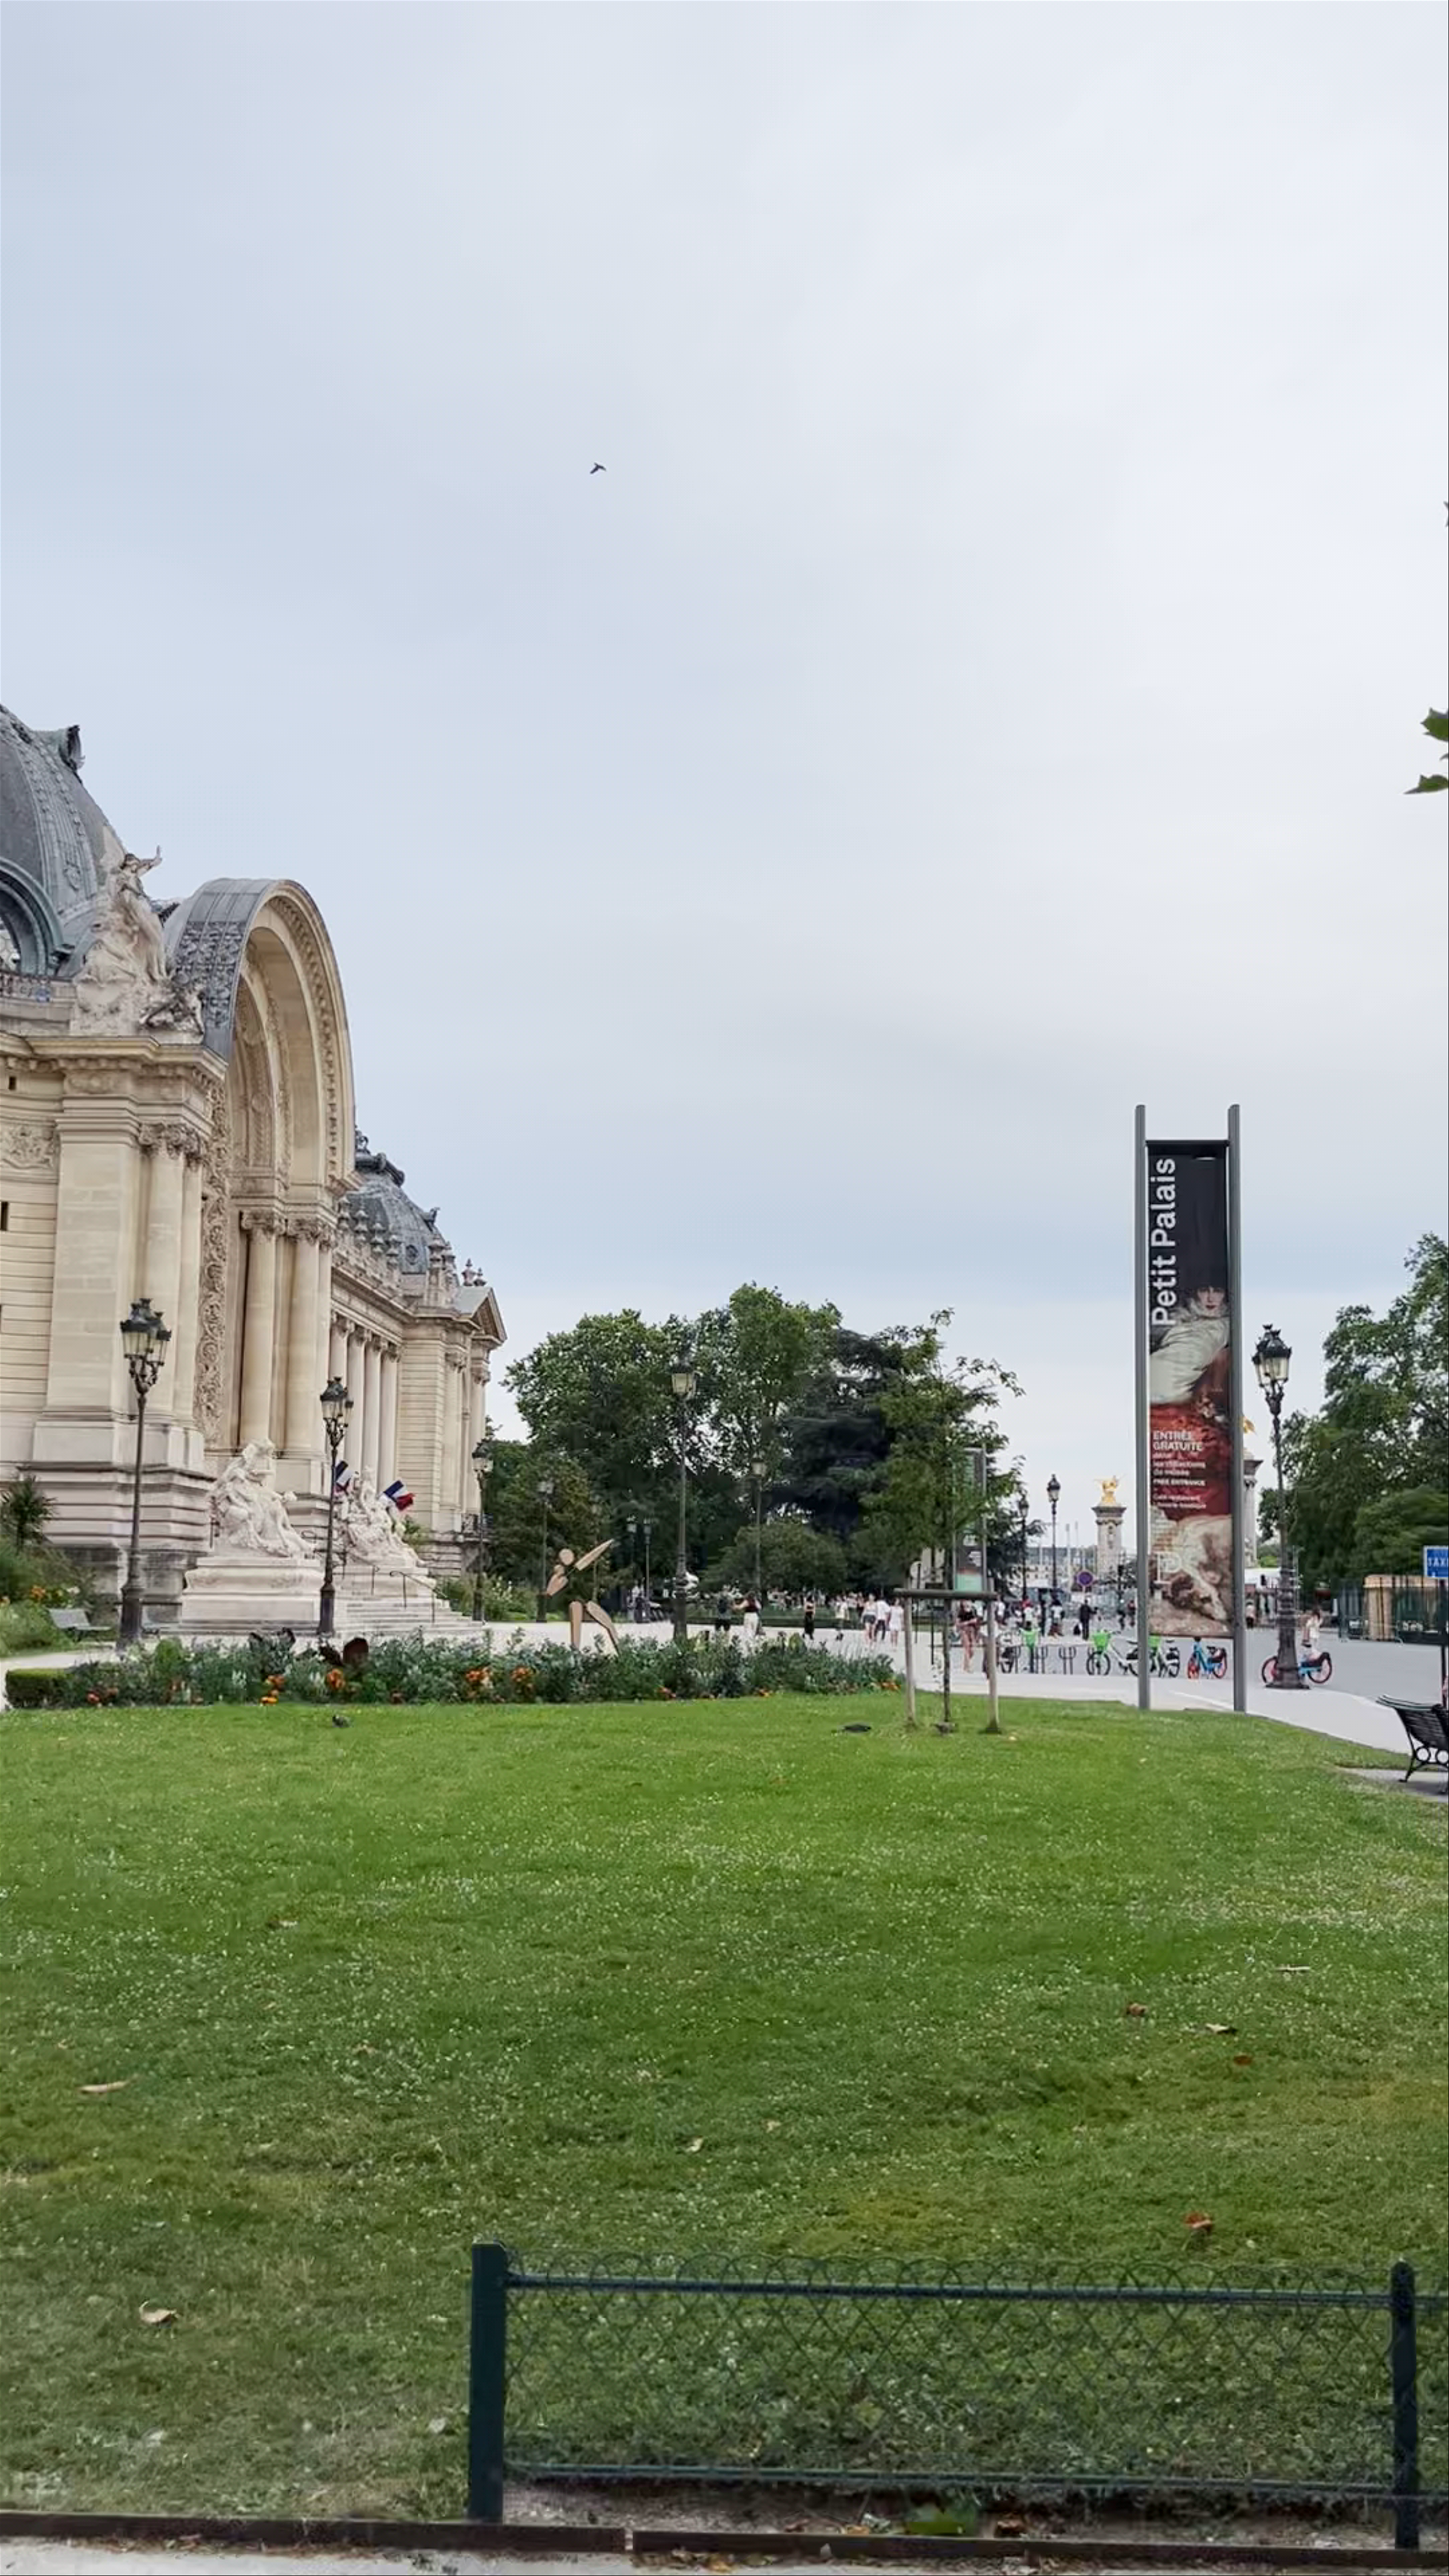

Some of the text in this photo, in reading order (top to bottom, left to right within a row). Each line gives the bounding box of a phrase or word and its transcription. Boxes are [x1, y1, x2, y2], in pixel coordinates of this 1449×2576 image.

[1151, 1158, 1177, 1325] Petit Palais
[1153, 1430, 1192, 1440] ENTRÉE
[1153, 1441, 1203, 1451] GRATUITE
